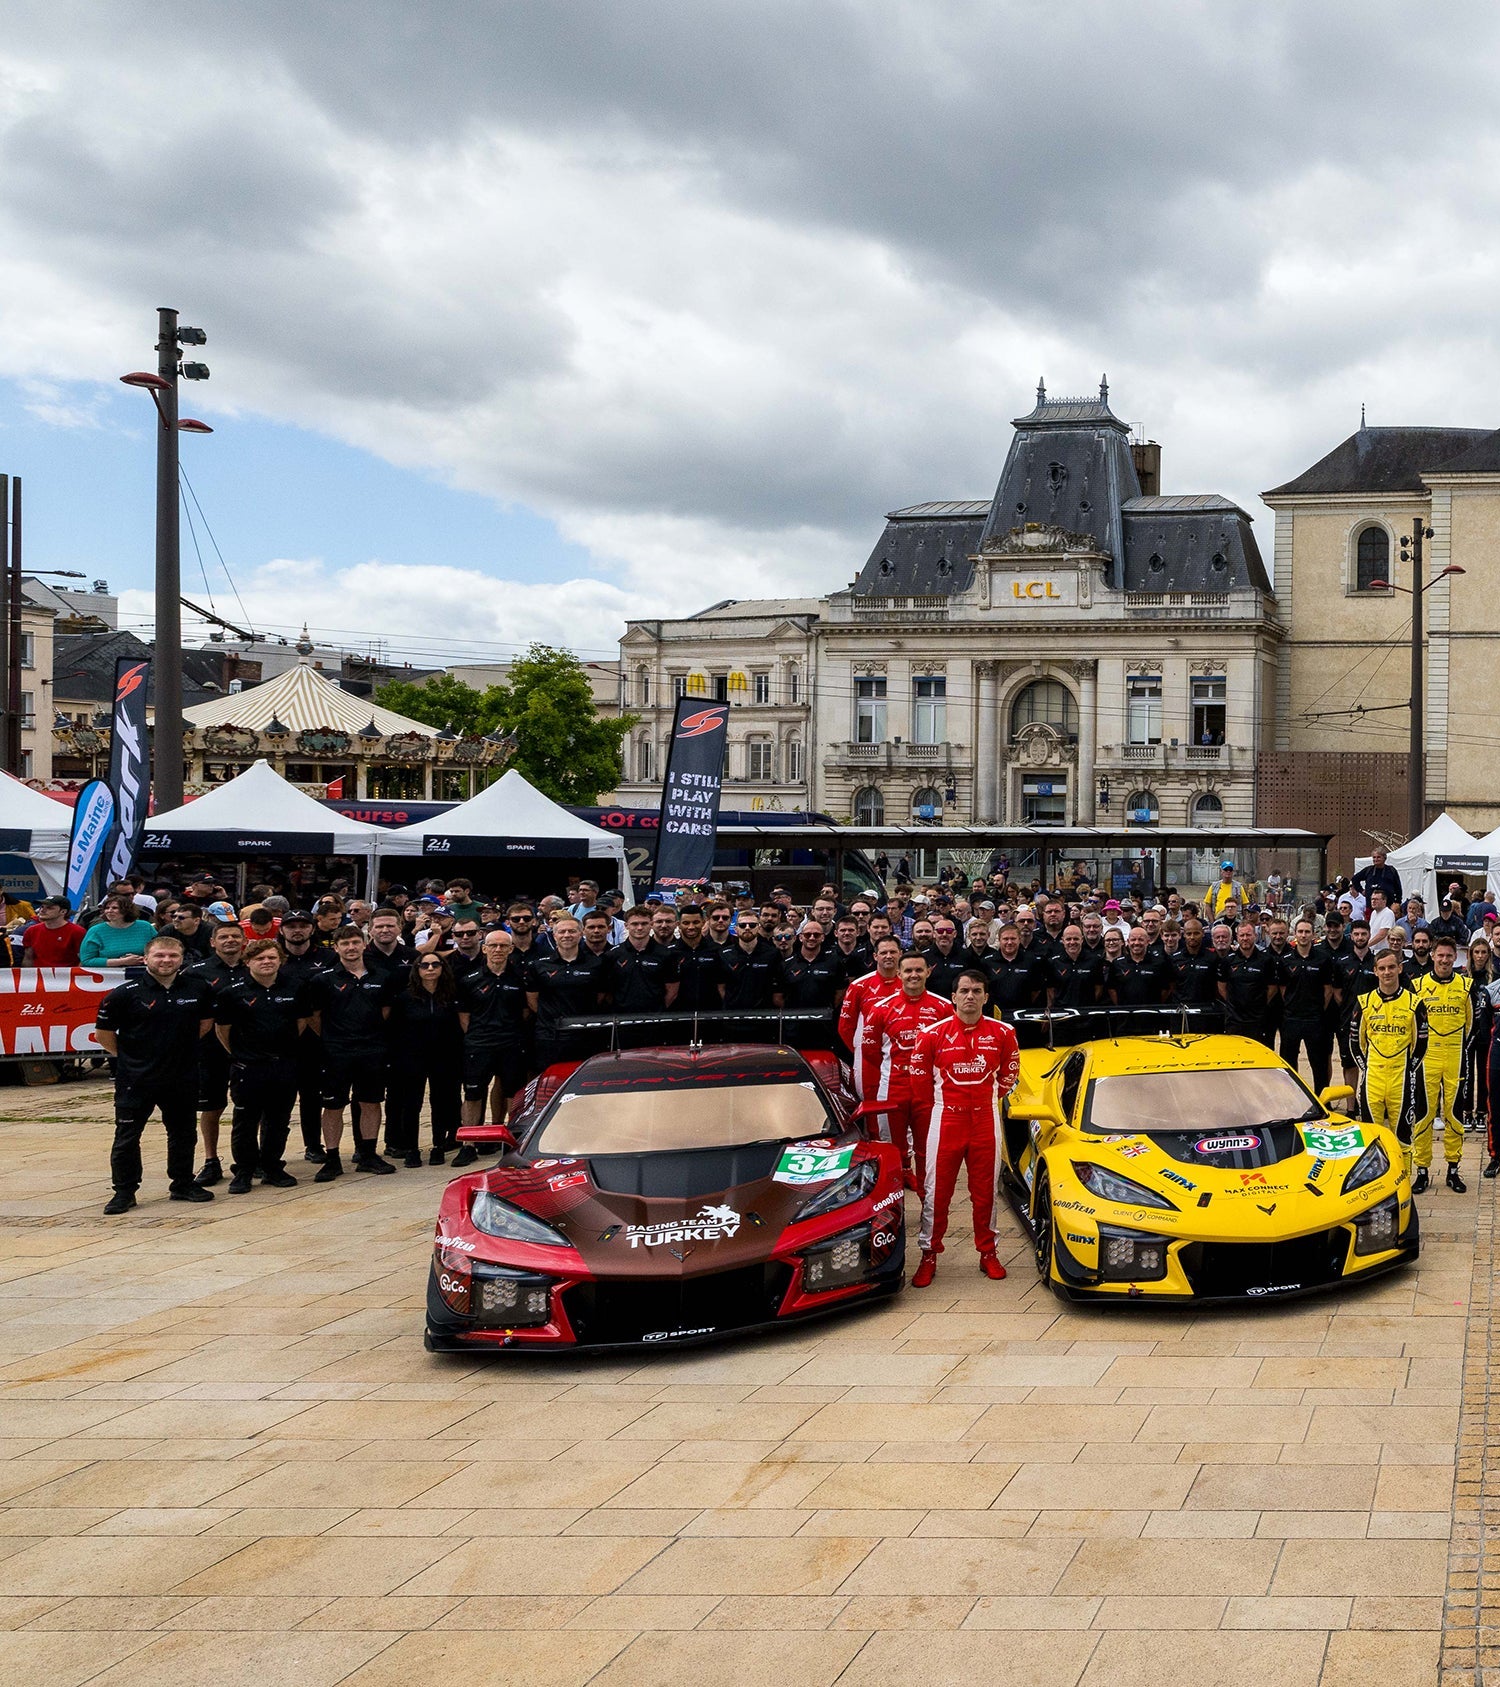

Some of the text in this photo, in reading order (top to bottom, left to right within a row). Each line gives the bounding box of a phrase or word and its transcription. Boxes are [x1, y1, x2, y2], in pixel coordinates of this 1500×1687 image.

[1013, 581, 1060, 599] LCL
[669, 771, 720, 788] I STILL
[671, 788, 713, 804] PLAY
[668, 804, 712, 819] WITH
[72, 795, 106, 873] Le Maine
[666, 821, 712, 836] CARS
[1370, 1023, 1406, 1035] Keating
[1126, 1060, 1256, 1071] CORVETTE
[581, 1070, 800, 1087] CORVETTE
[1311, 1133, 1358, 1150] 33
[788, 1153, 840, 1174] 34
[1248, 1184, 1290, 1192] CONNECT
[1053, 1200, 1096, 1215] GOODYEAR
[627, 1219, 718, 1232] RACING TEAM
[625, 1224, 741, 1249] TURKEY
[1268, 1283, 1301, 1292] SPORT
[670, 1327, 715, 1337] SPORT
